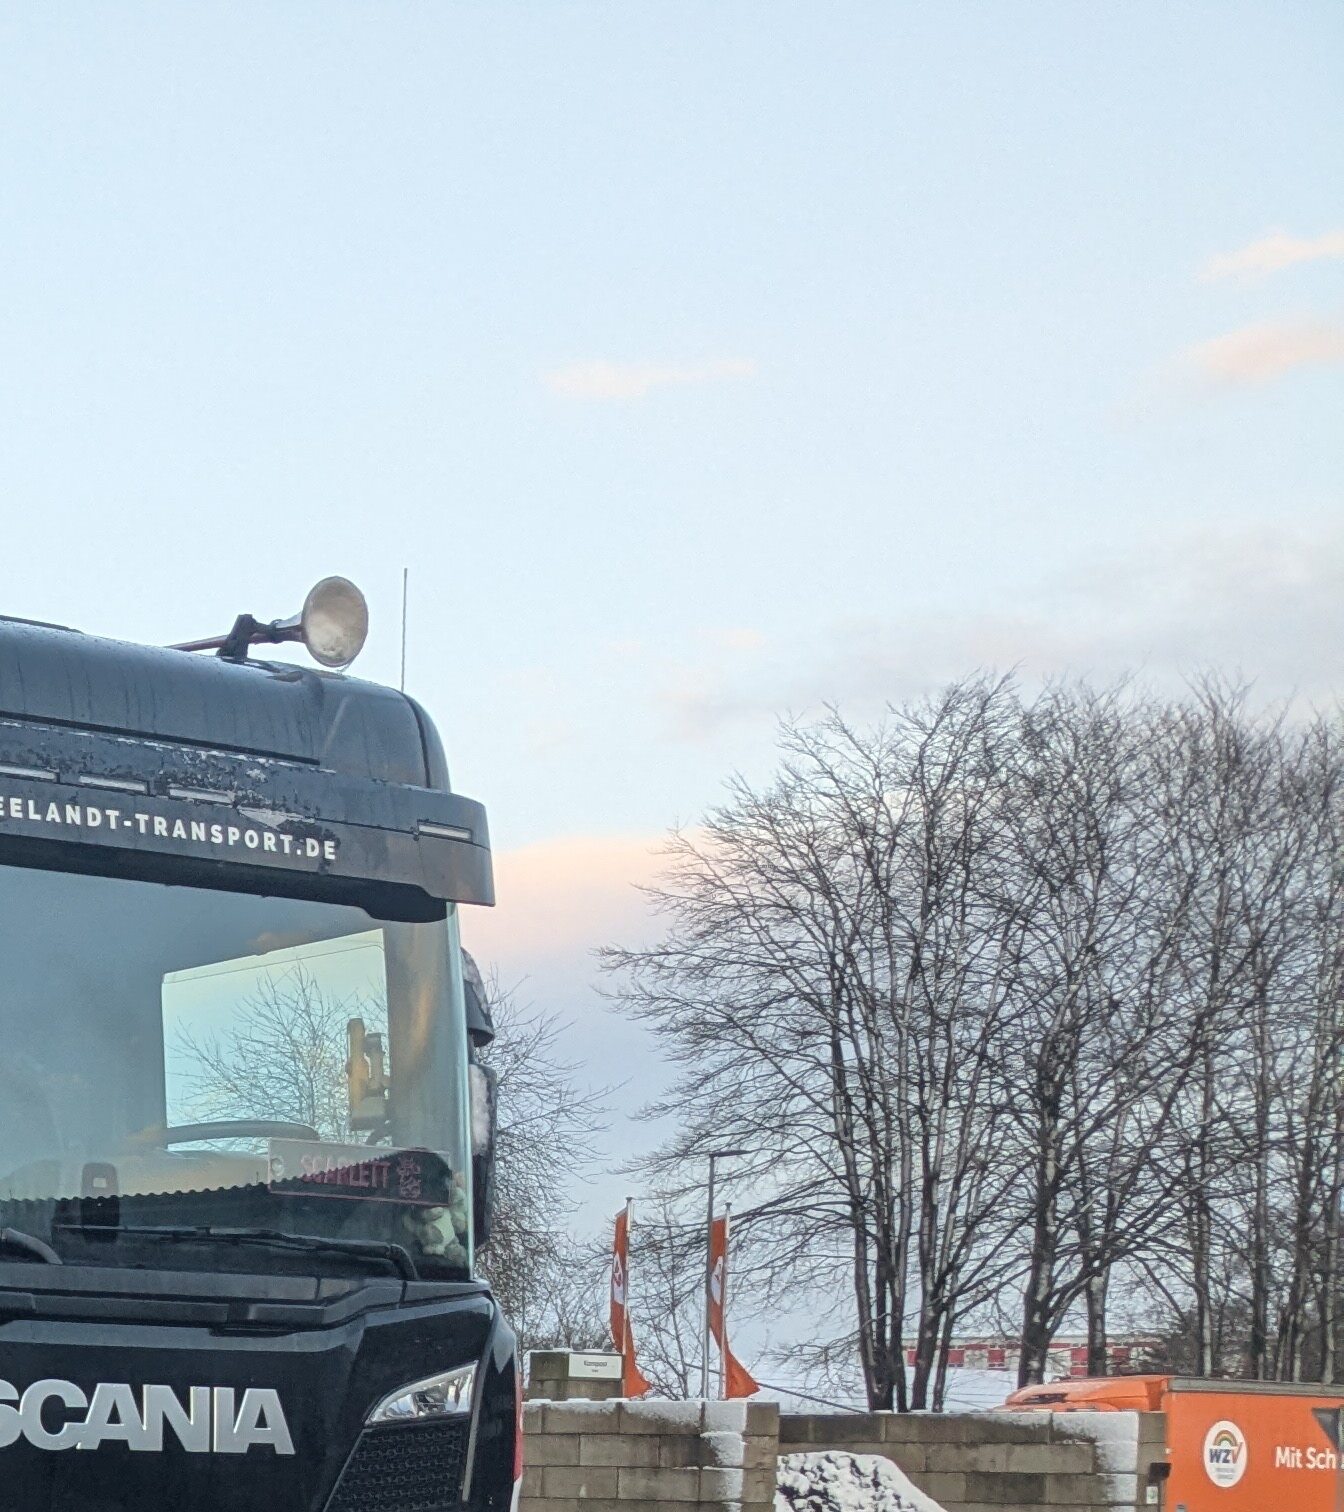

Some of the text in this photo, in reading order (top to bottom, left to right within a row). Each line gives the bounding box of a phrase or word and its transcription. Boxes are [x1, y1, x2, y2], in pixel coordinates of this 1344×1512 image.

[1209, 1442, 1243, 1464] WZV
[1275, 1446, 1344, 1470] Mit Sch
